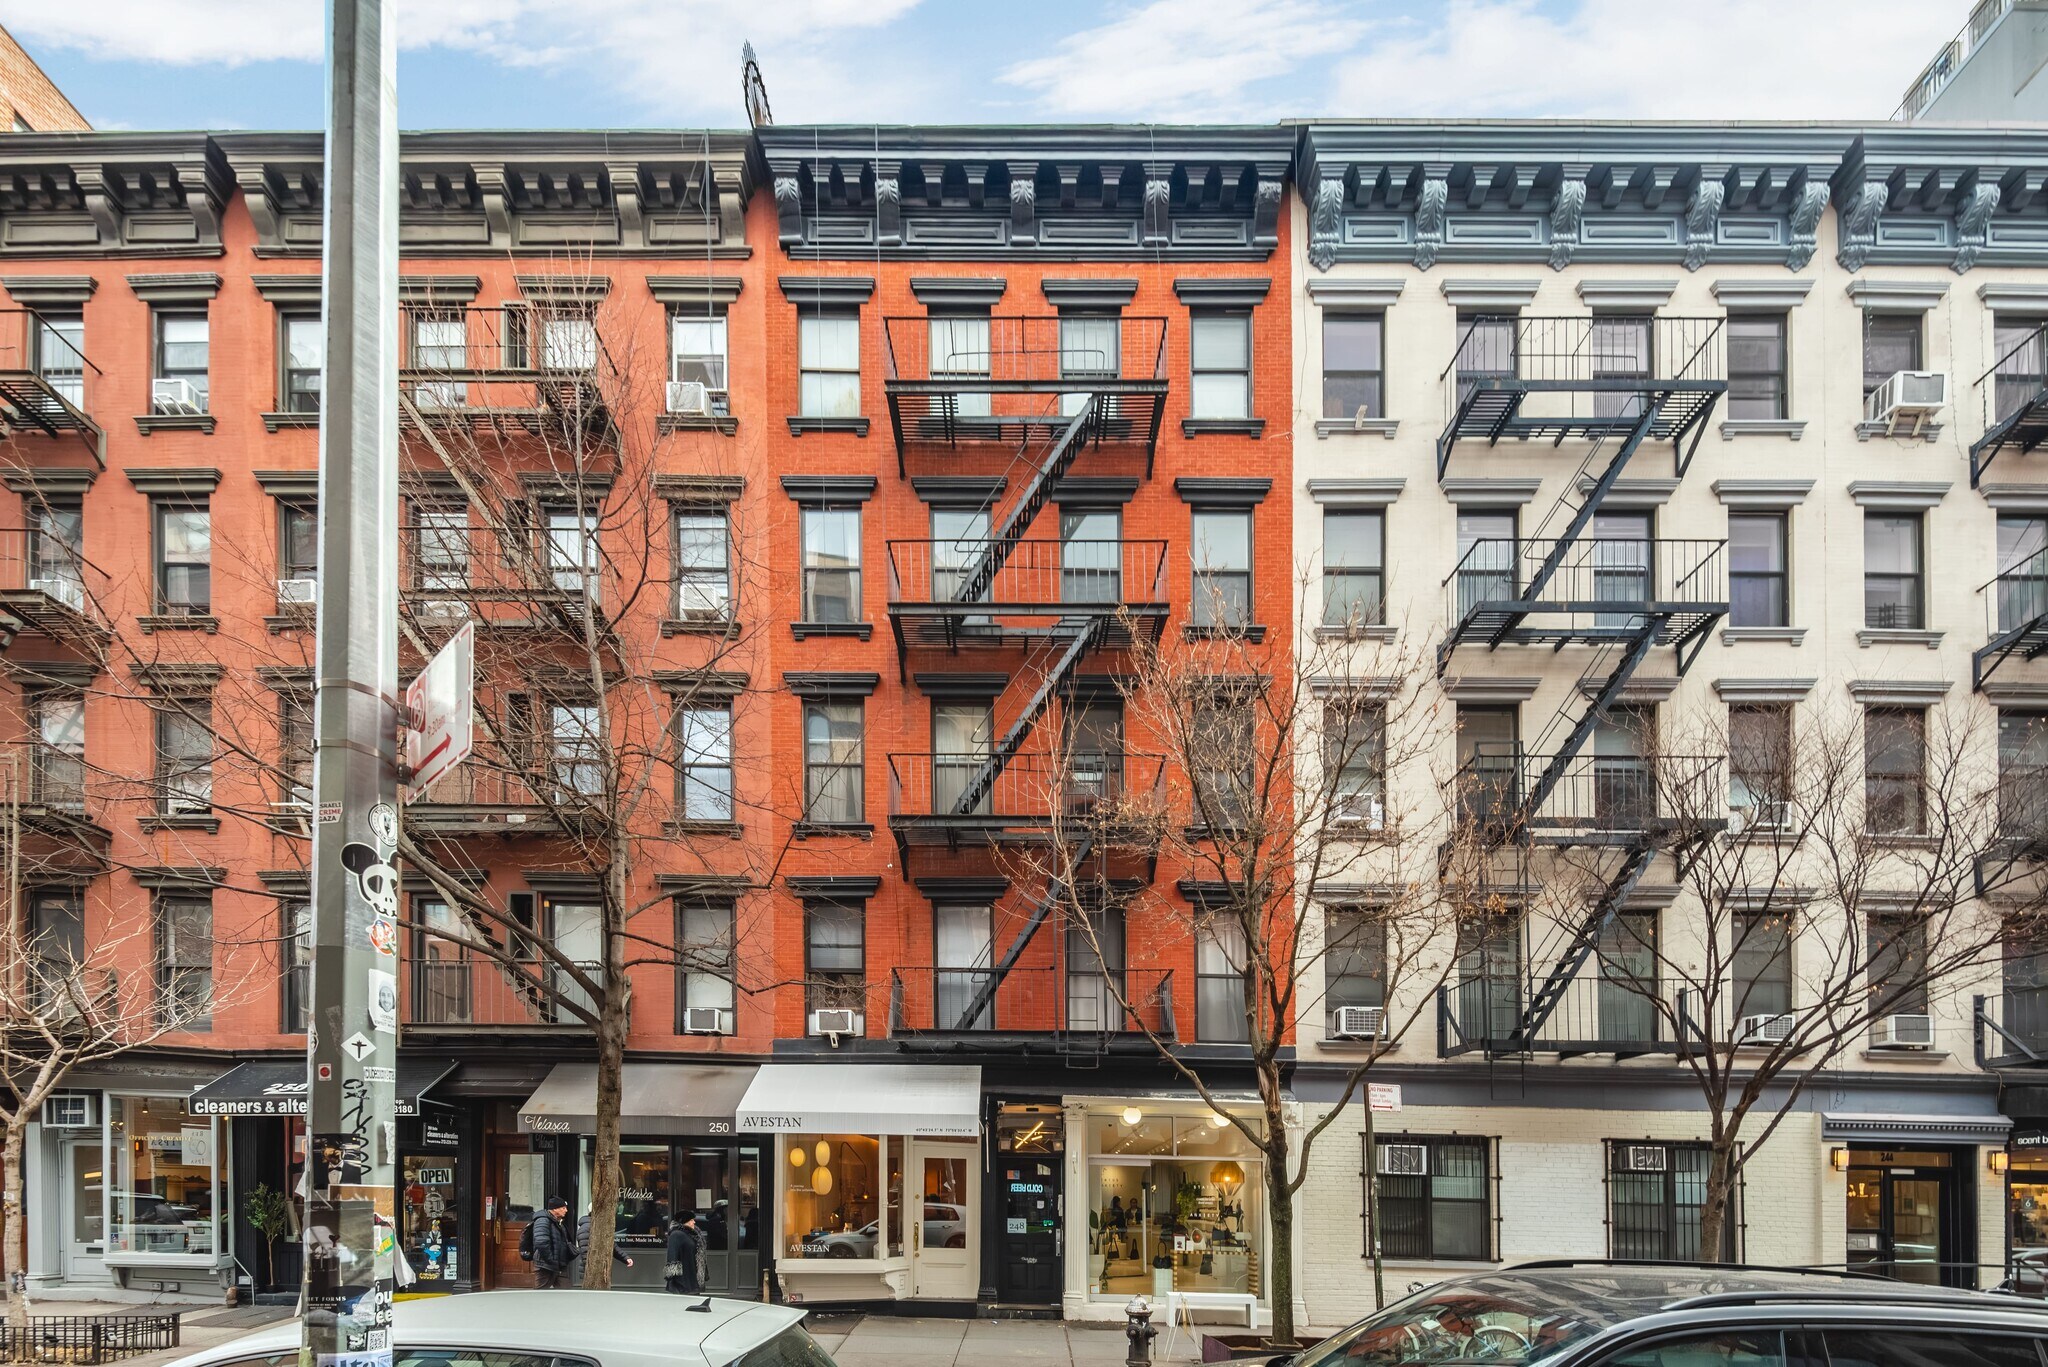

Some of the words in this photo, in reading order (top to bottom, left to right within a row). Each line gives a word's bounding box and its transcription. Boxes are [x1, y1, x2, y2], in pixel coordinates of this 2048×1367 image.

[262, 1083, 308, 1092] 250
[194, 1099, 262, 1113] cleaners
[264, 1101, 275, 1113] &
[524, 1115, 571, 1131] Velasca
[742, 1116, 802, 1127] AVESTAN
[708, 1122, 730, 1133] 250
[2017, 1136, 2041, 1145] scent
[1880, 1152, 1894, 1162] 244
[421, 1169, 450, 1184] OPEN
[2025, 1199, 2031, 1208] 6
[1009, 1221, 1025, 1231] 248
[789, 1244, 830, 1253] AVESTAN
